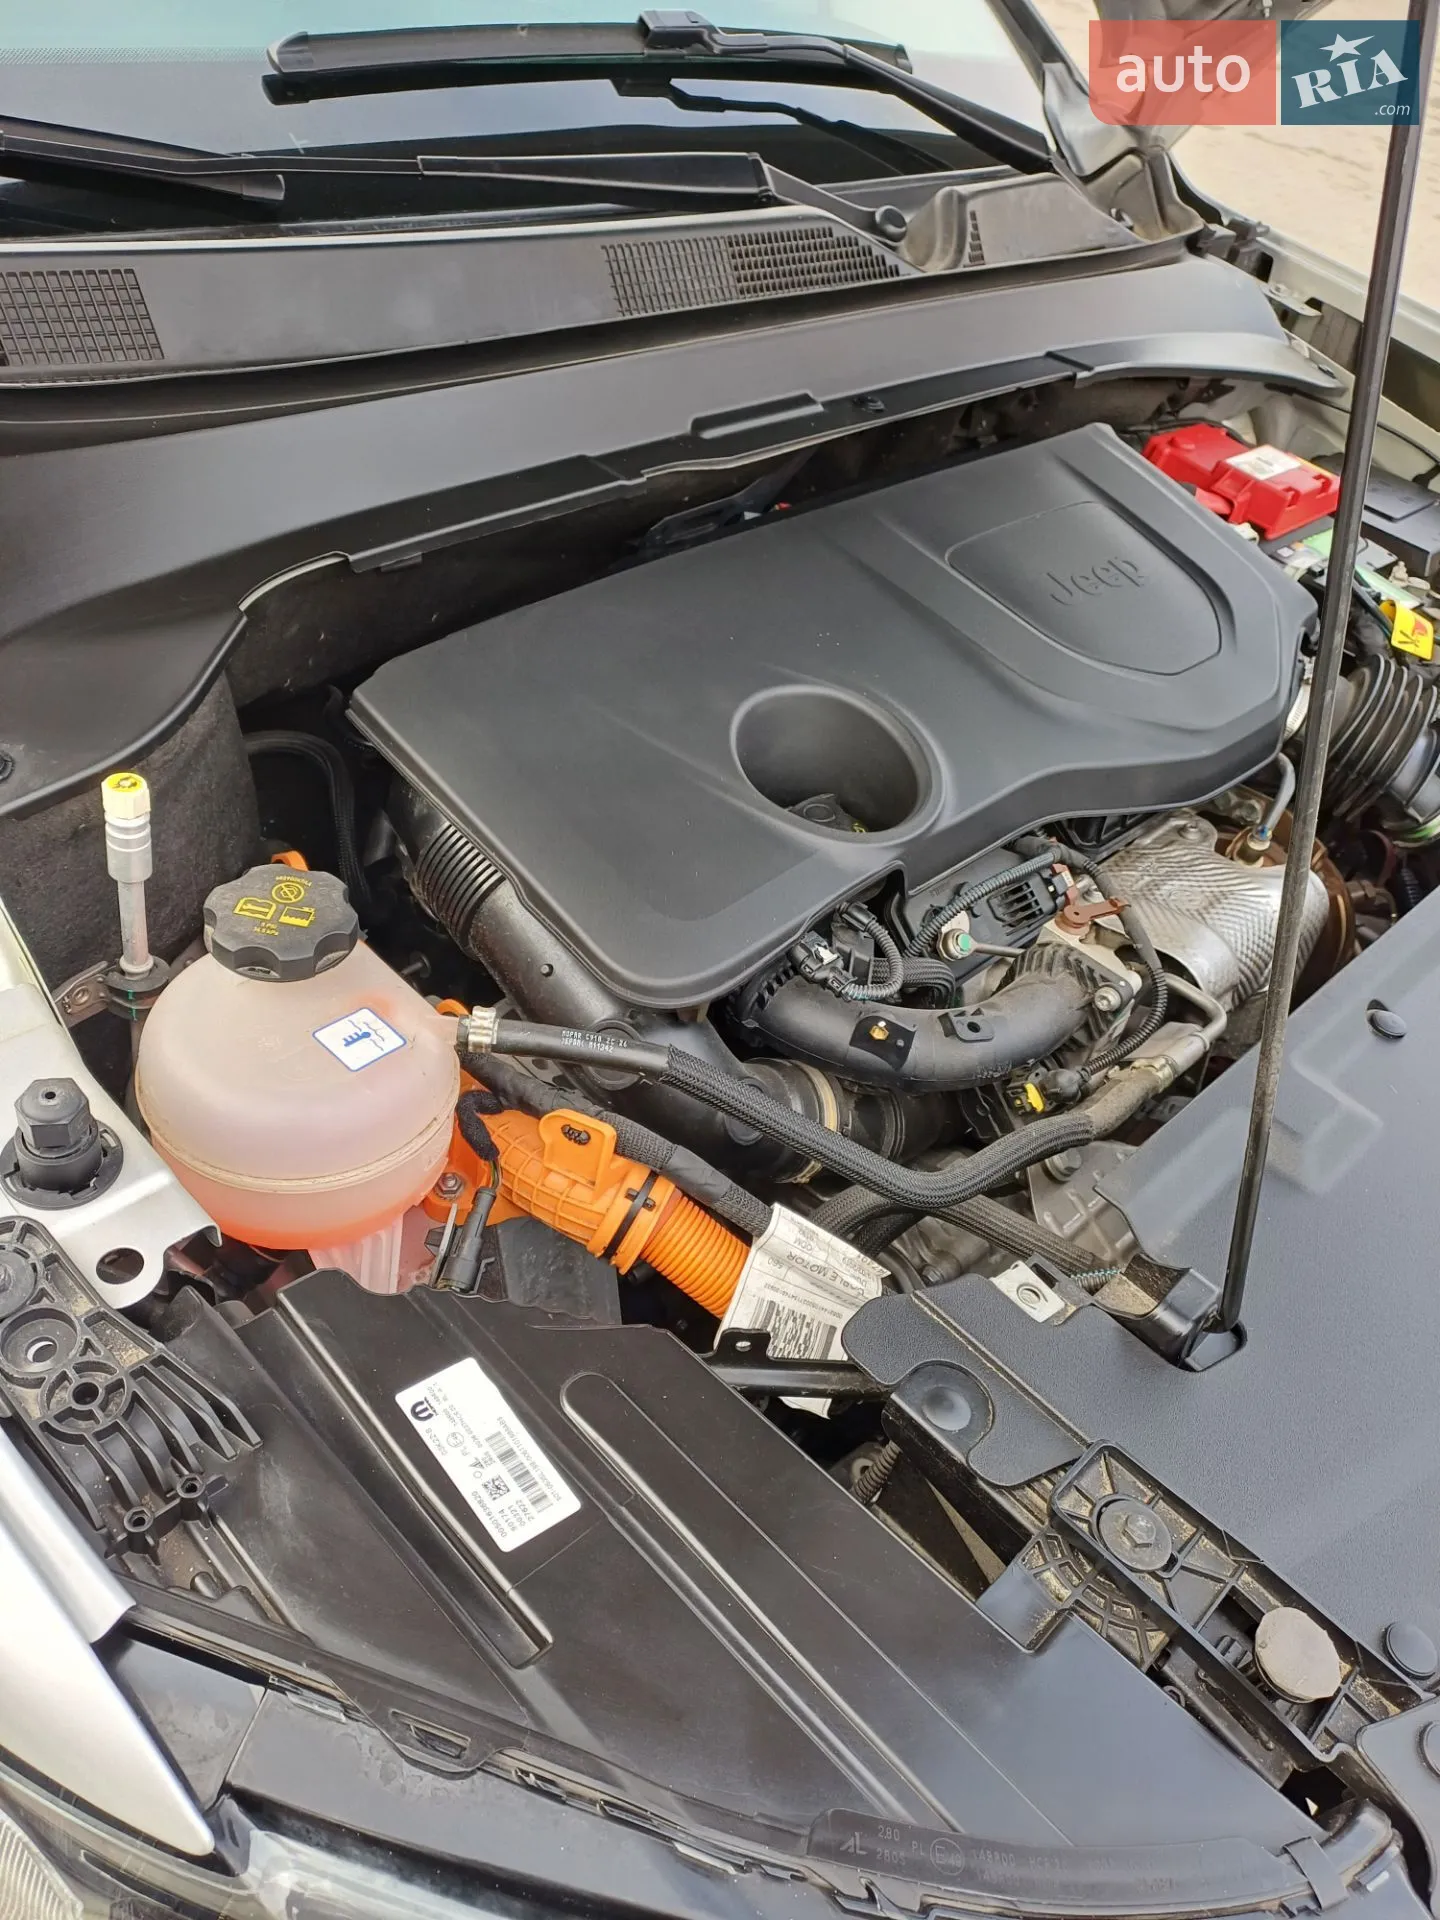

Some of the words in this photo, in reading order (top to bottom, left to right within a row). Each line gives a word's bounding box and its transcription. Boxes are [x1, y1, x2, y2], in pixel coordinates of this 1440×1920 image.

[1046, 557, 1144, 606] Jeep
[787, 1251, 829, 1277] MOTOR
[912, 1841, 924, 1856] PL
